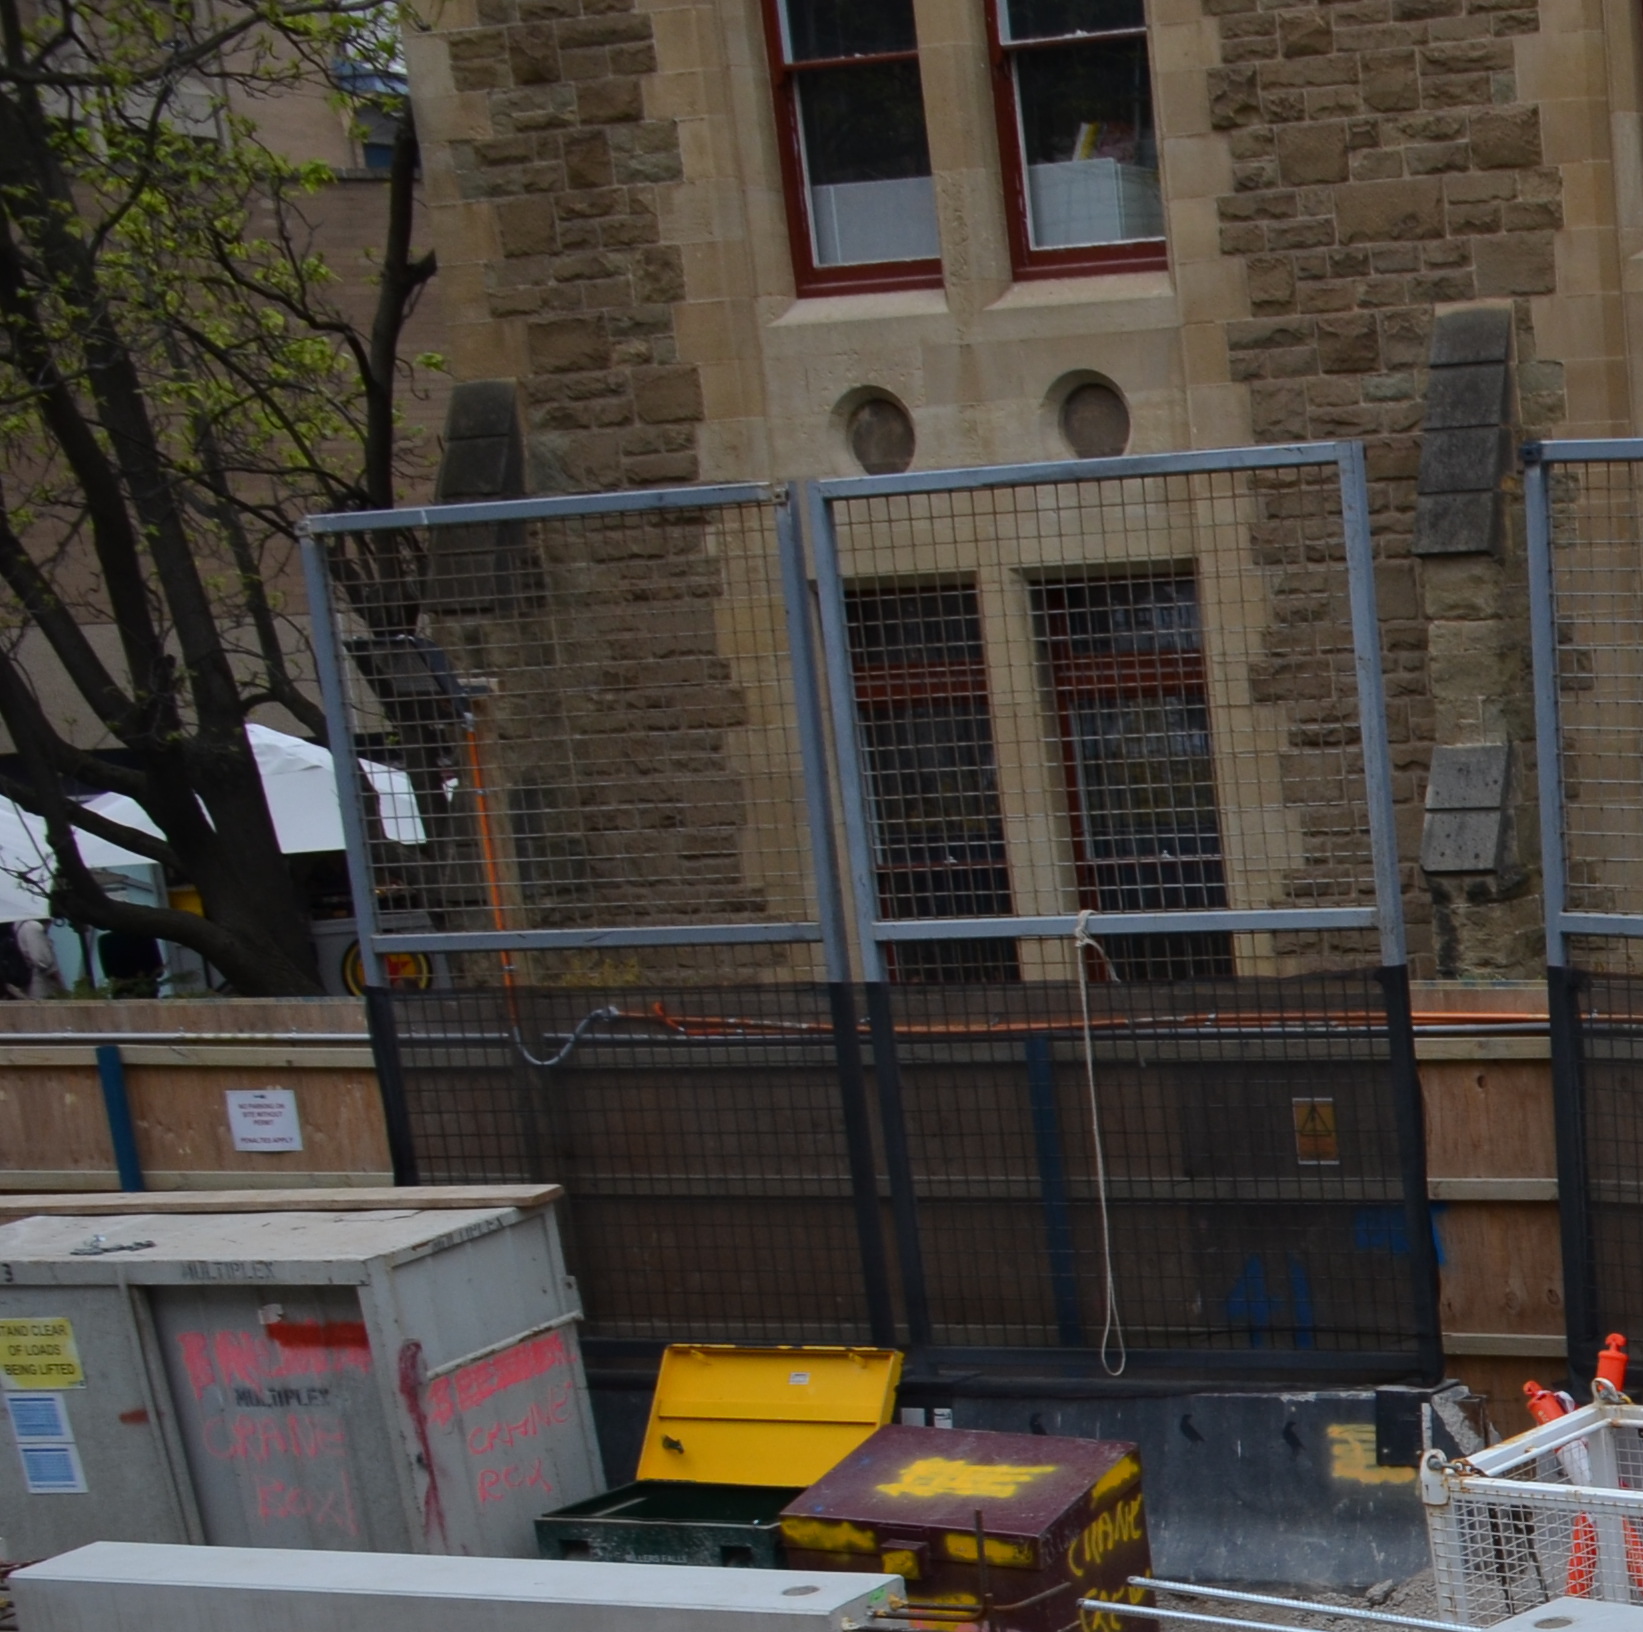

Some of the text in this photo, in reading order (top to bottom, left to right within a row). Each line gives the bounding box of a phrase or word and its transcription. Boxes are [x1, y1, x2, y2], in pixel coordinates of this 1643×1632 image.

[182, 1260, 276, 1281] MULTIPLEX
[0, 1324, 68, 1337] TAND CLEAR
[8, 1344, 61, 1356] OF LOADS
[4, 1363, 76, 1376] BEING LIFTED
[234, 1387, 330, 1408] MULTIPLEX
